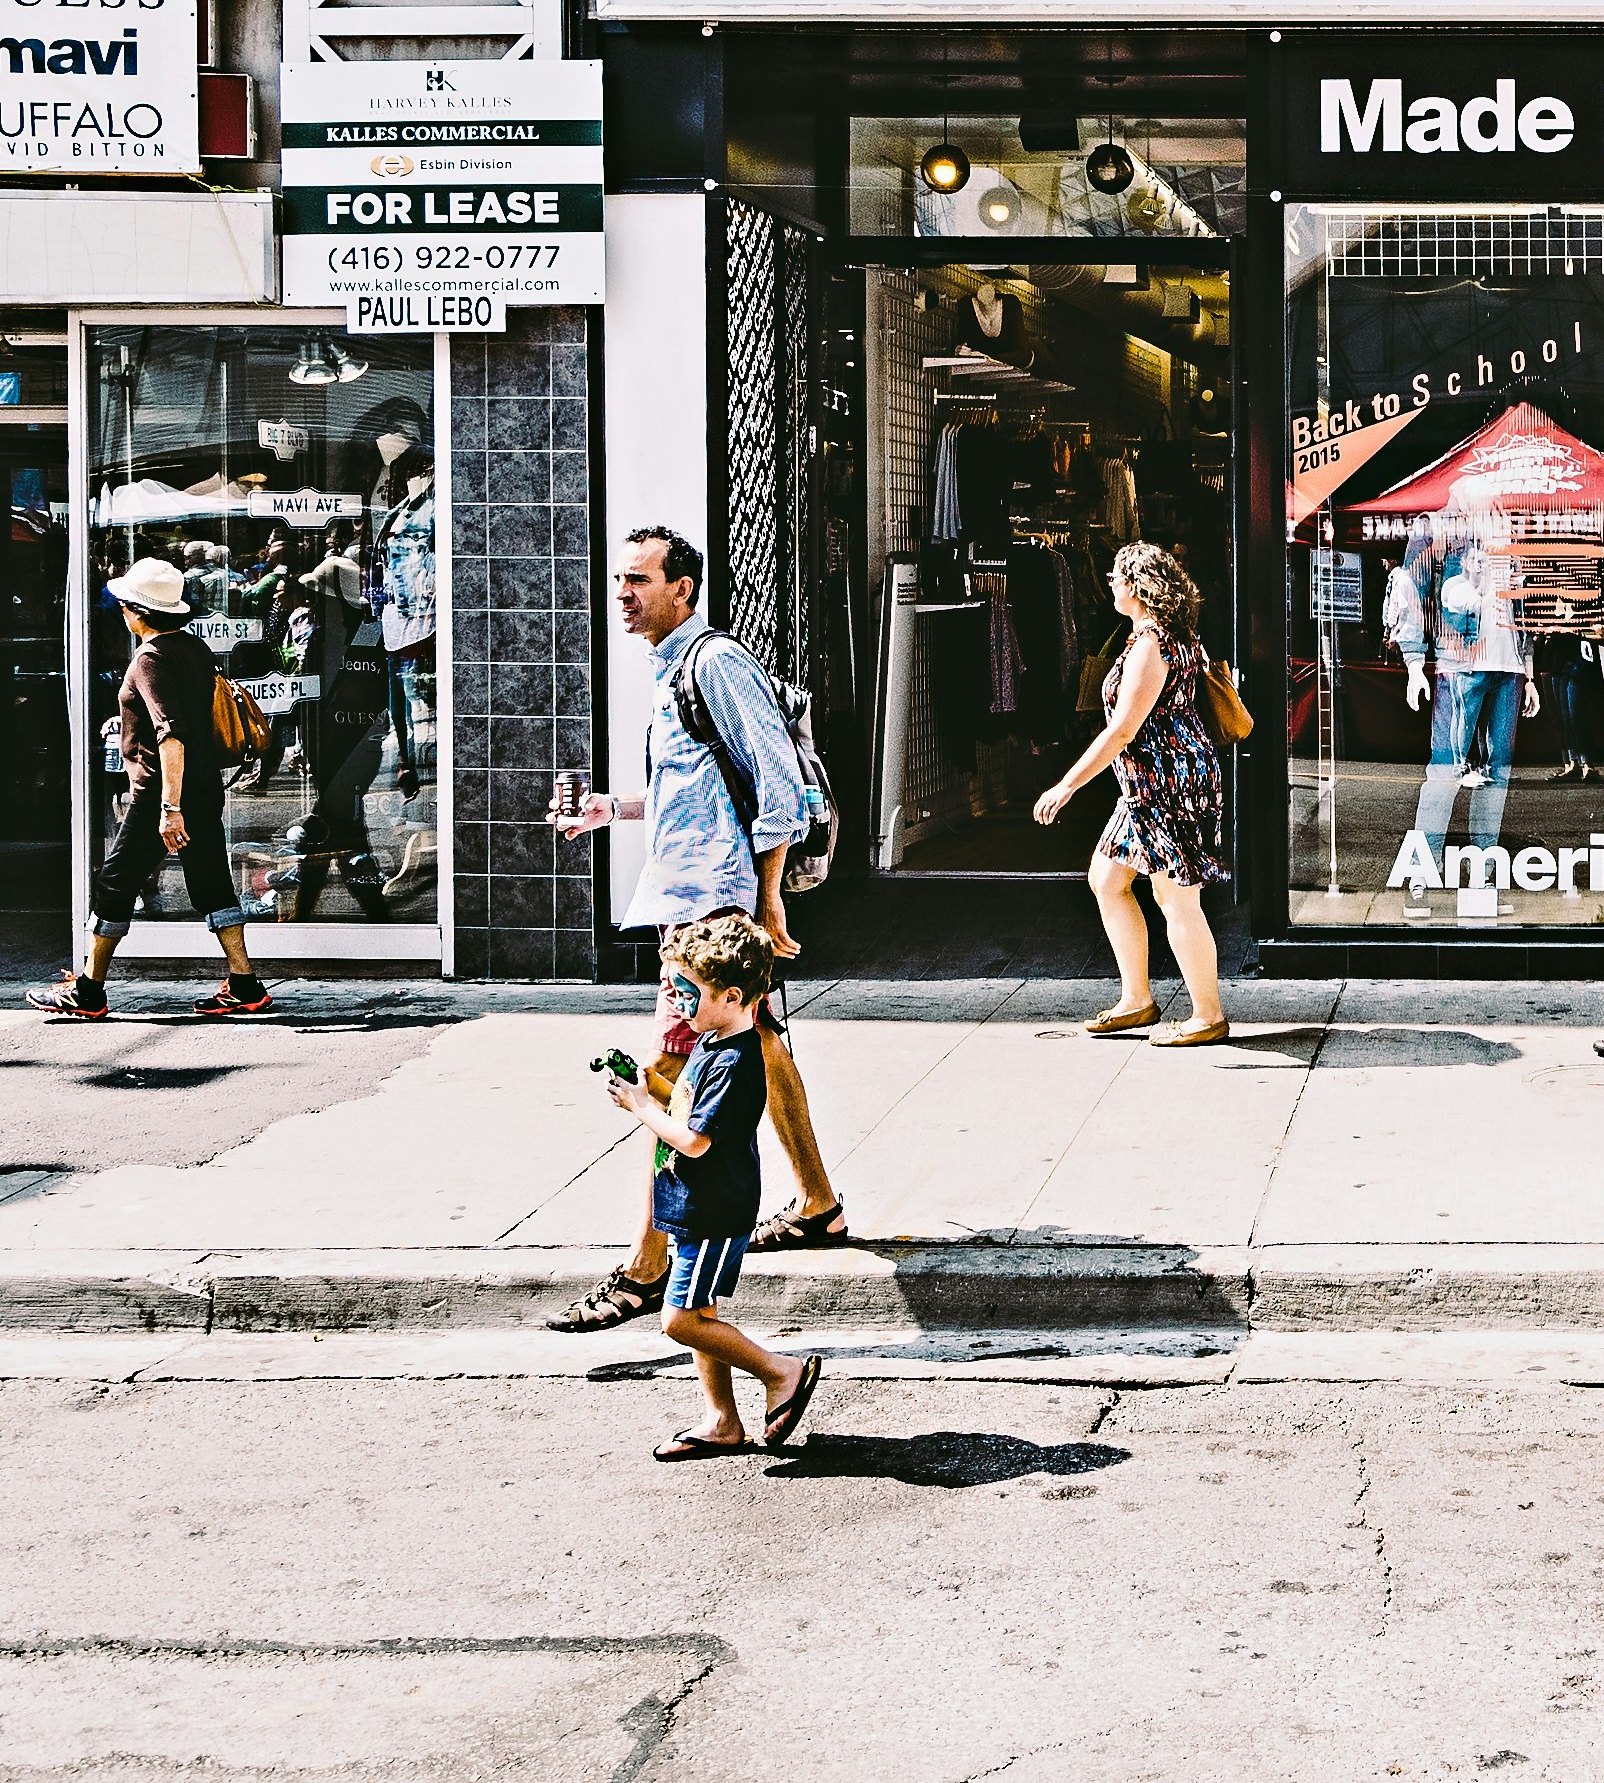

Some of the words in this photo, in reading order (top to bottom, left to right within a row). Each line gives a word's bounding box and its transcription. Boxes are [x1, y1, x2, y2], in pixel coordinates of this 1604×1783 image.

[0, 28, 138, 76] mavi
[370, 98, 436, 108] HARVEY
[448, 97, 512, 108] KALLES
[1320, 78, 1575, 153] Made
[326, 126, 398, 142] KALLES
[401, 125, 540, 141] COMMERCIAL
[72, 143, 165, 157] BITTON
[420, 159, 455, 170] Esbin
[460, 159, 512, 170] Division
[327, 192, 412, 225] FOR
[425, 191, 560, 224] LEASE
[329, 246, 403, 273] (416)
[416, 246, 560, 269] 922-0777
[329, 278, 560, 292] www.kallescommercial.com
[358, 296, 420, 327] PAUL
[427, 296, 492, 326] LEBO
[1293, 400, 1363, 449] Back
[1371, 391, 1401, 420] to
[1412, 321, 1582, 408] School
[1297, 443, 1341, 474] 2015
[273, 498, 308, 513] MAVI
[316, 498, 342, 513] AVE
[188, 622, 229, 639] SILVER
[235, 624, 248, 638] ST
[291, 681, 306, 697] PL
[334, 710, 386, 725] GUESS
